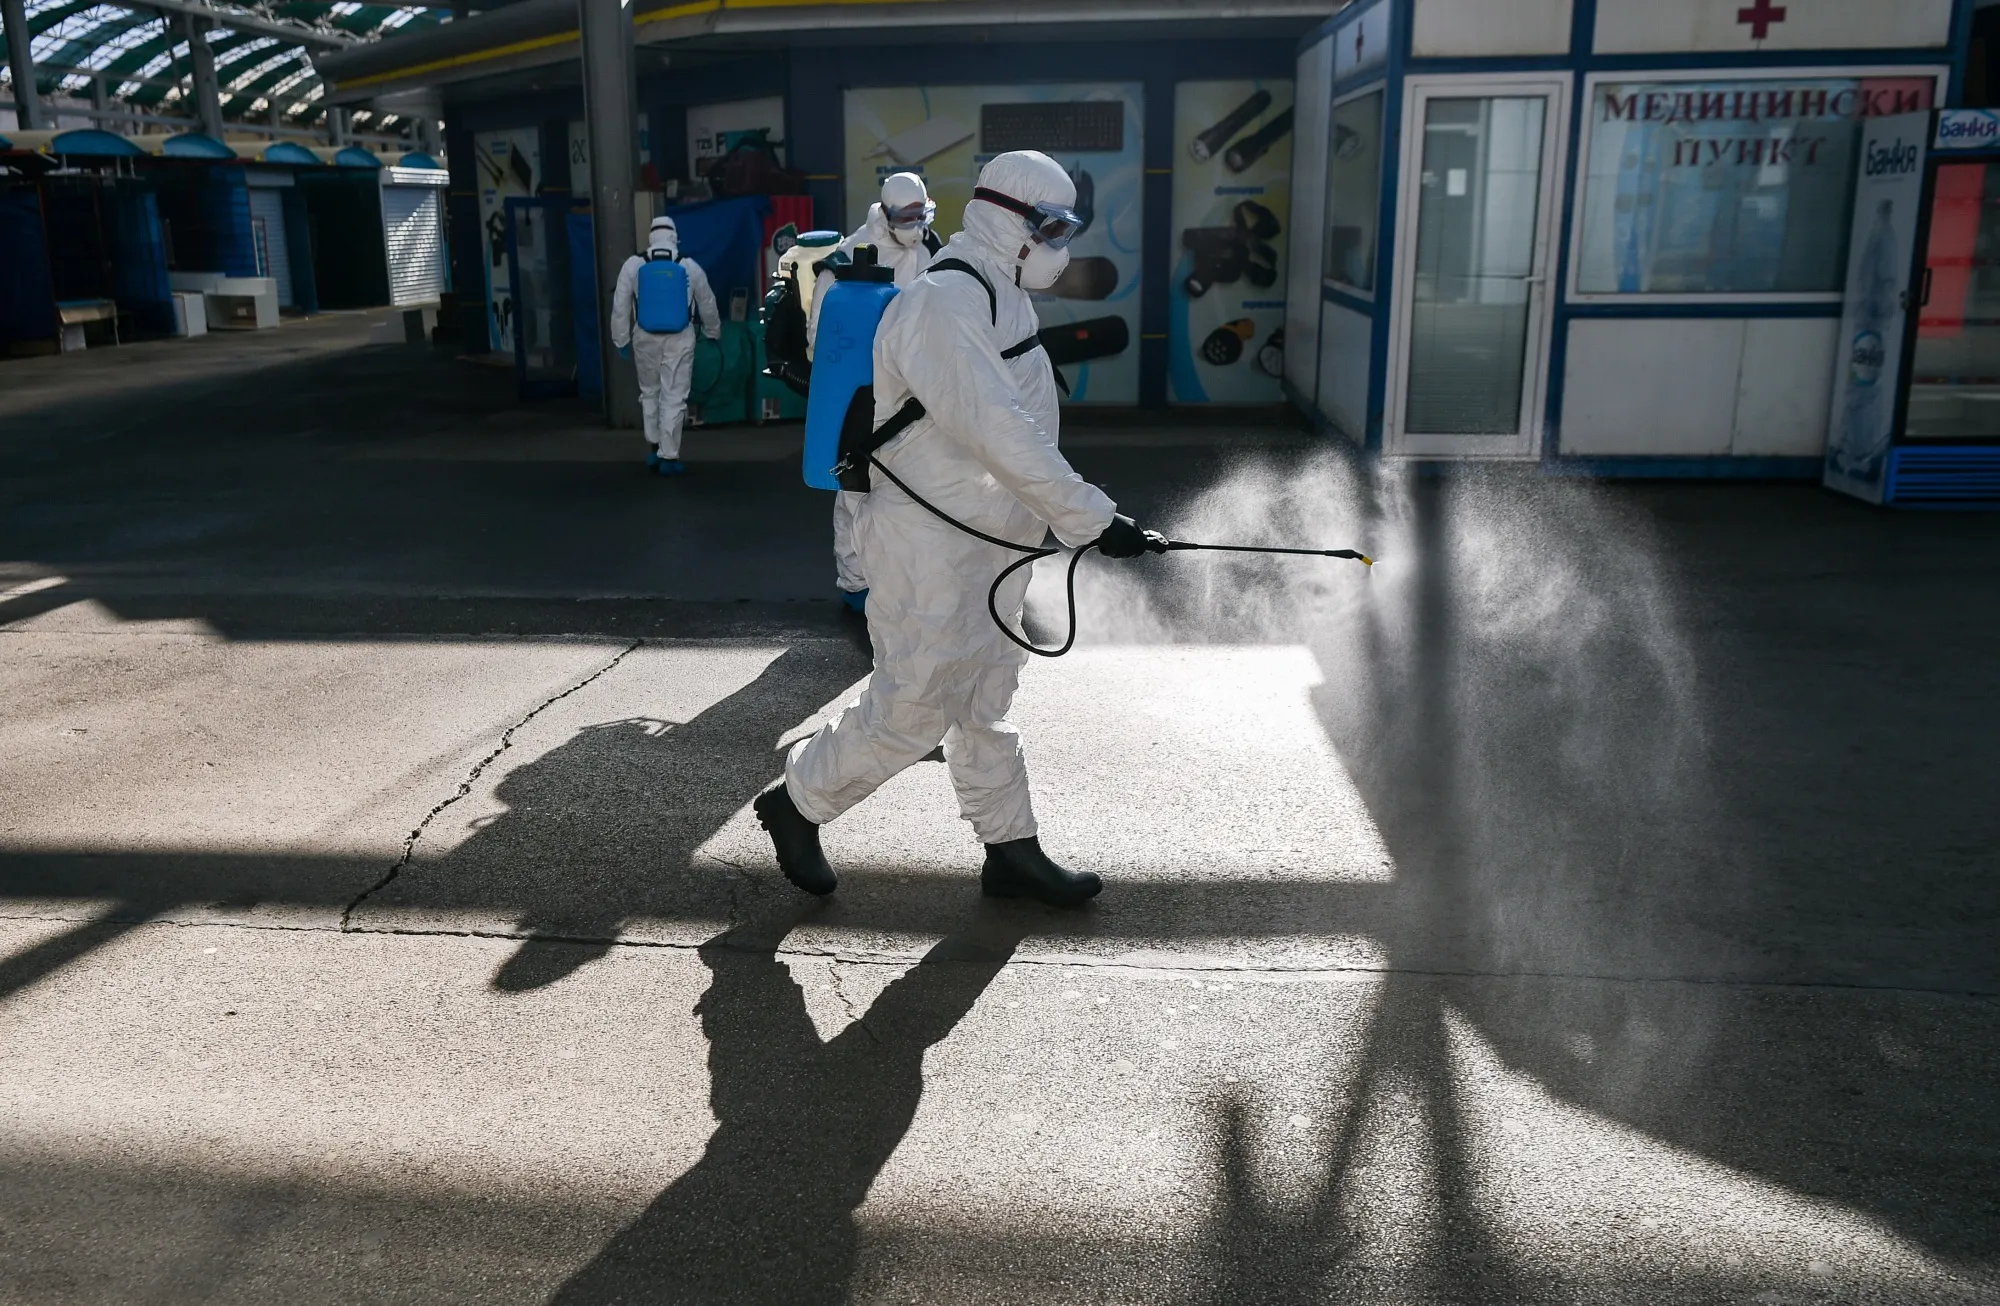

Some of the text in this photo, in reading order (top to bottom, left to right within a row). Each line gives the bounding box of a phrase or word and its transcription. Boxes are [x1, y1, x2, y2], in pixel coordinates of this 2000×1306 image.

[1604, 88, 1921, 124] МЕДИЦИНСКИ
[1939, 115, 1998, 138] Банкя
[1672, 135, 1829, 167] ПУНКТ
[1866, 136, 1918, 176] Банкя
